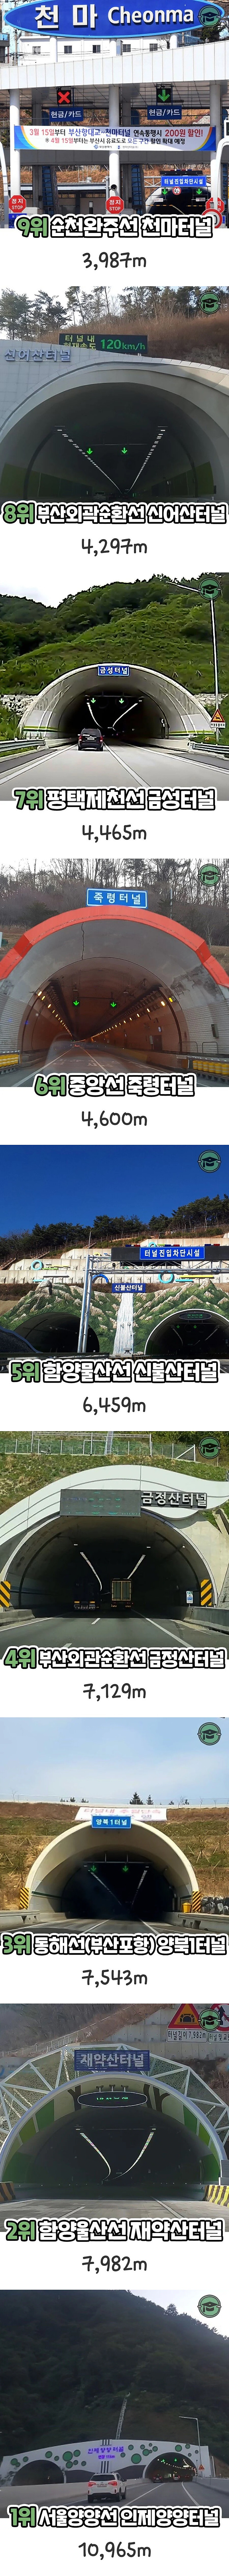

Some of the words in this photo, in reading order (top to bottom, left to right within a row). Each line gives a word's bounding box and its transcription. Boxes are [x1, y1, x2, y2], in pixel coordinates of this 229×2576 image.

[108, 6, 194, 24] Cheonma
[51, 110, 82, 118] 현금/카드
[149, 108, 181, 117] 현금/카드
[68, 128, 130, 137] 부산항대교~천마터널
[188, 129, 203, 137] 할인!
[101, 339, 145, 350] 120km/h
[4, 349, 71, 362] 신어산터널
[93, 892, 141, 905] 죽령터널
[144, 1249, 200, 1257] 터널진입차단시설
[141, 1491, 207, 1507] 금정산터널
[168, 2031, 187, 2040] 터널길이
[189, 2031, 206, 2039] 7,982m
[81, 2053, 144, 2067] 재약산터널
